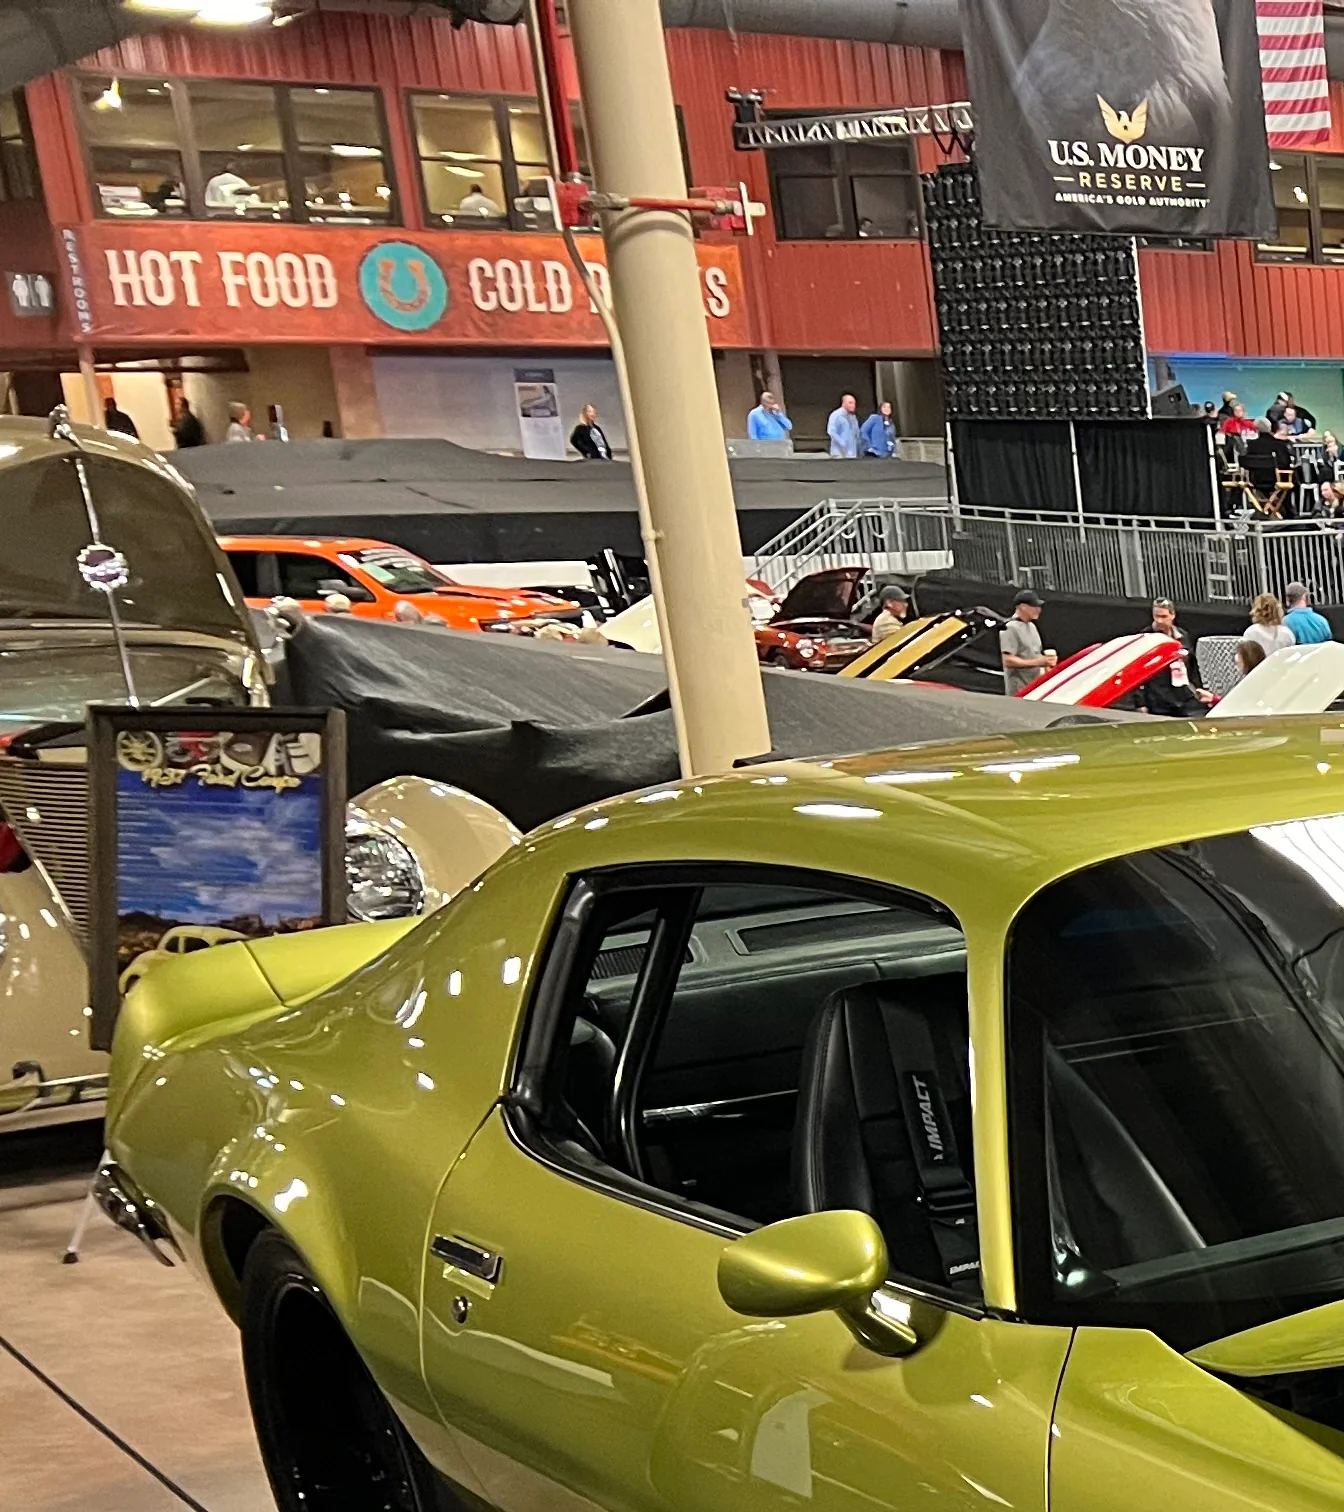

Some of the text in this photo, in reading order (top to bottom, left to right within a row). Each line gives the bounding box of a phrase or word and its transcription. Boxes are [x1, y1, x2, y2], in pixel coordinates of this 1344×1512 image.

[1048, 140, 1204, 172] U.S. MONEY
[1055, 192, 1114, 205] AMERICA'S
[1116, 195, 1146, 206] GOLD
[1079, 171, 1183, 192] RESERVE
[62, 228, 93, 334] RESTROOMS
[104, 249, 338, 308] HOT FOOD
[468, 257, 573, 313] COLD
[911, 1074, 944, 1152] IMPACT
[949, 1261, 980, 1275] IMPA
